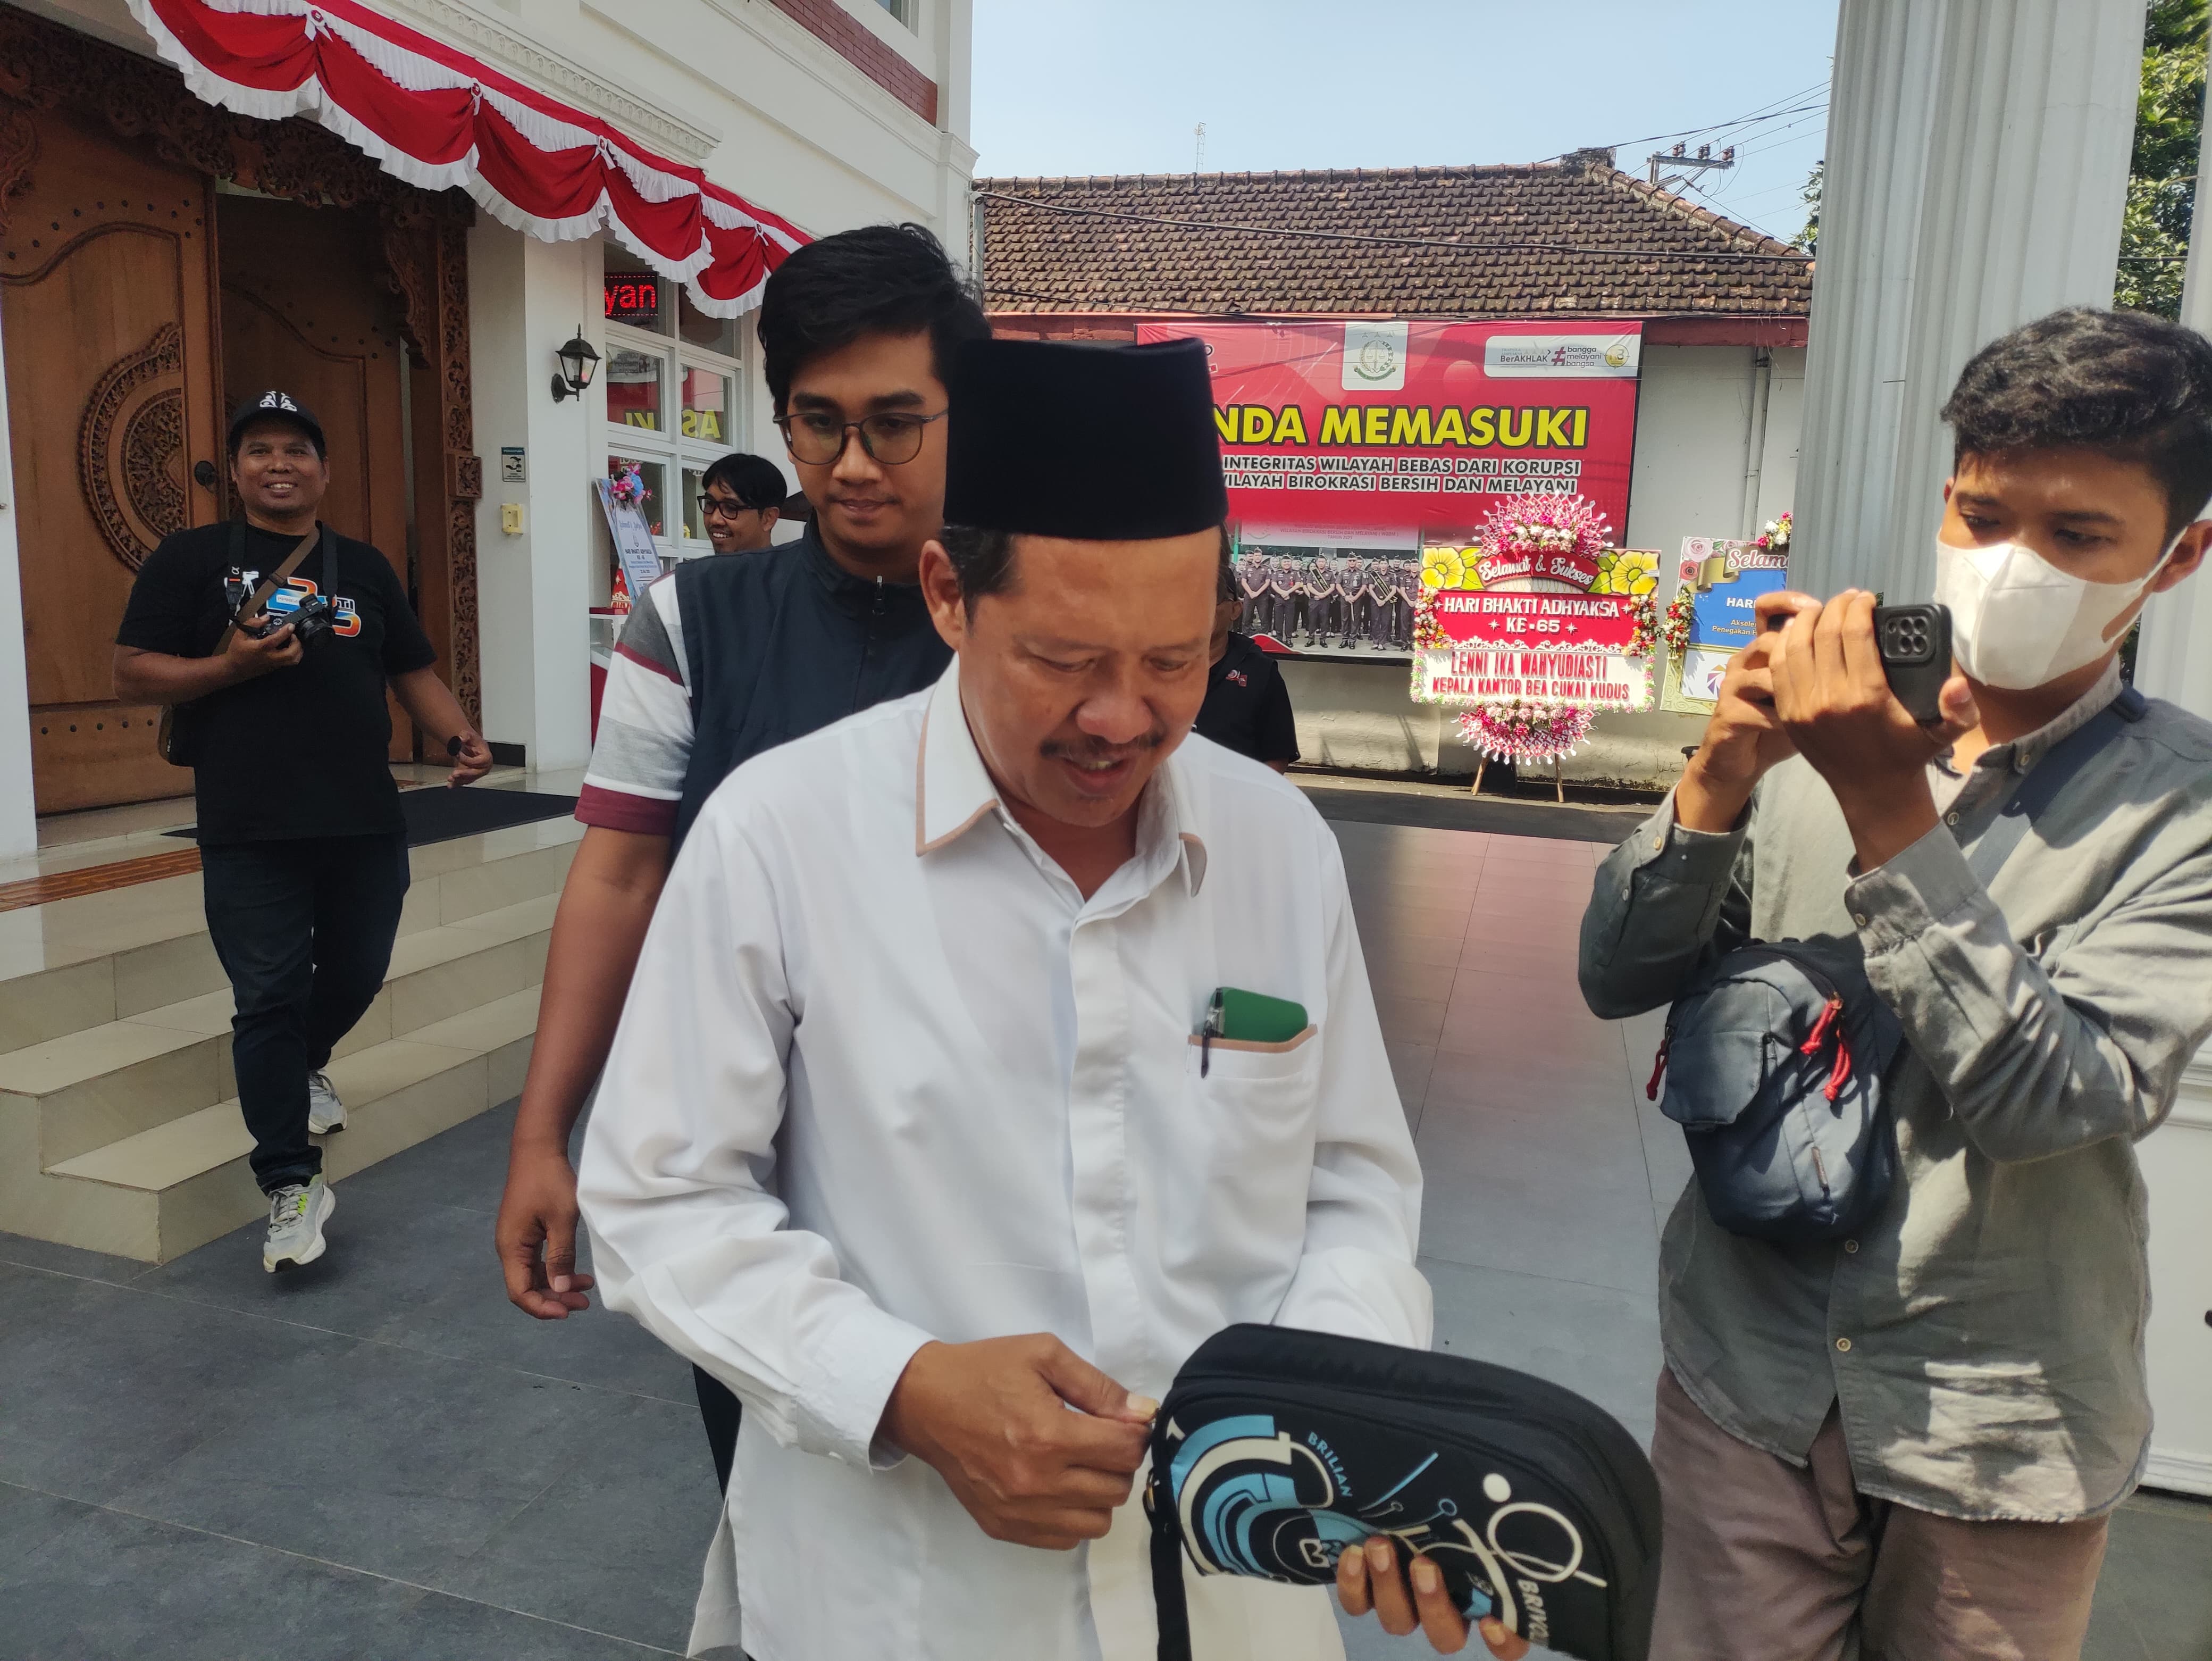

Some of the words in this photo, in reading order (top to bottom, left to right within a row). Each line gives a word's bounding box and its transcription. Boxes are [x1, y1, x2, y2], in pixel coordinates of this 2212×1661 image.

[1320, 407, 1588, 447] MEMASUKI
[1224, 456, 1315, 470] INTEGRITAS
[1320, 458, 1393, 472] WILAYAH
[1398, 459, 1451, 473] BEBAS
[1457, 460, 1497, 474] DARI
[1503, 461, 1579, 475] KORUPSI
[1289, 475, 1375, 489] BIROKRASI
[1381, 477, 1438, 490] BERSIH
[1445, 478, 1482, 491] DAN
[1488, 479, 1576, 493] MELAYANI
[1479, 557, 1531, 581] Selamat
[1535, 555, 1545, 572] &
[1549, 557, 1595, 585] Sukses
[1444, 597, 1480, 613] HARI
[1481, 597, 1538, 614] BHAKTI
[1540, 599, 1620, 617] ADHYAKSA
[1712, 625, 1751, 635] Penegakan
[1452, 651, 1488, 677] LENNI
[1495, 652, 1515, 677] IKA
[1521, 653, 1607, 680] WAHYUDIASTI
[1433, 677, 1474, 694] KEPALA
[1478, 678, 1522, 695] KANTOR
[1526, 680, 1549, 696] BEA
[1552, 681, 1586, 698] CUKAI
[1590, 682, 1629, 700] KUDUS
[1308, 1431, 1353, 1497] BRILIAN
